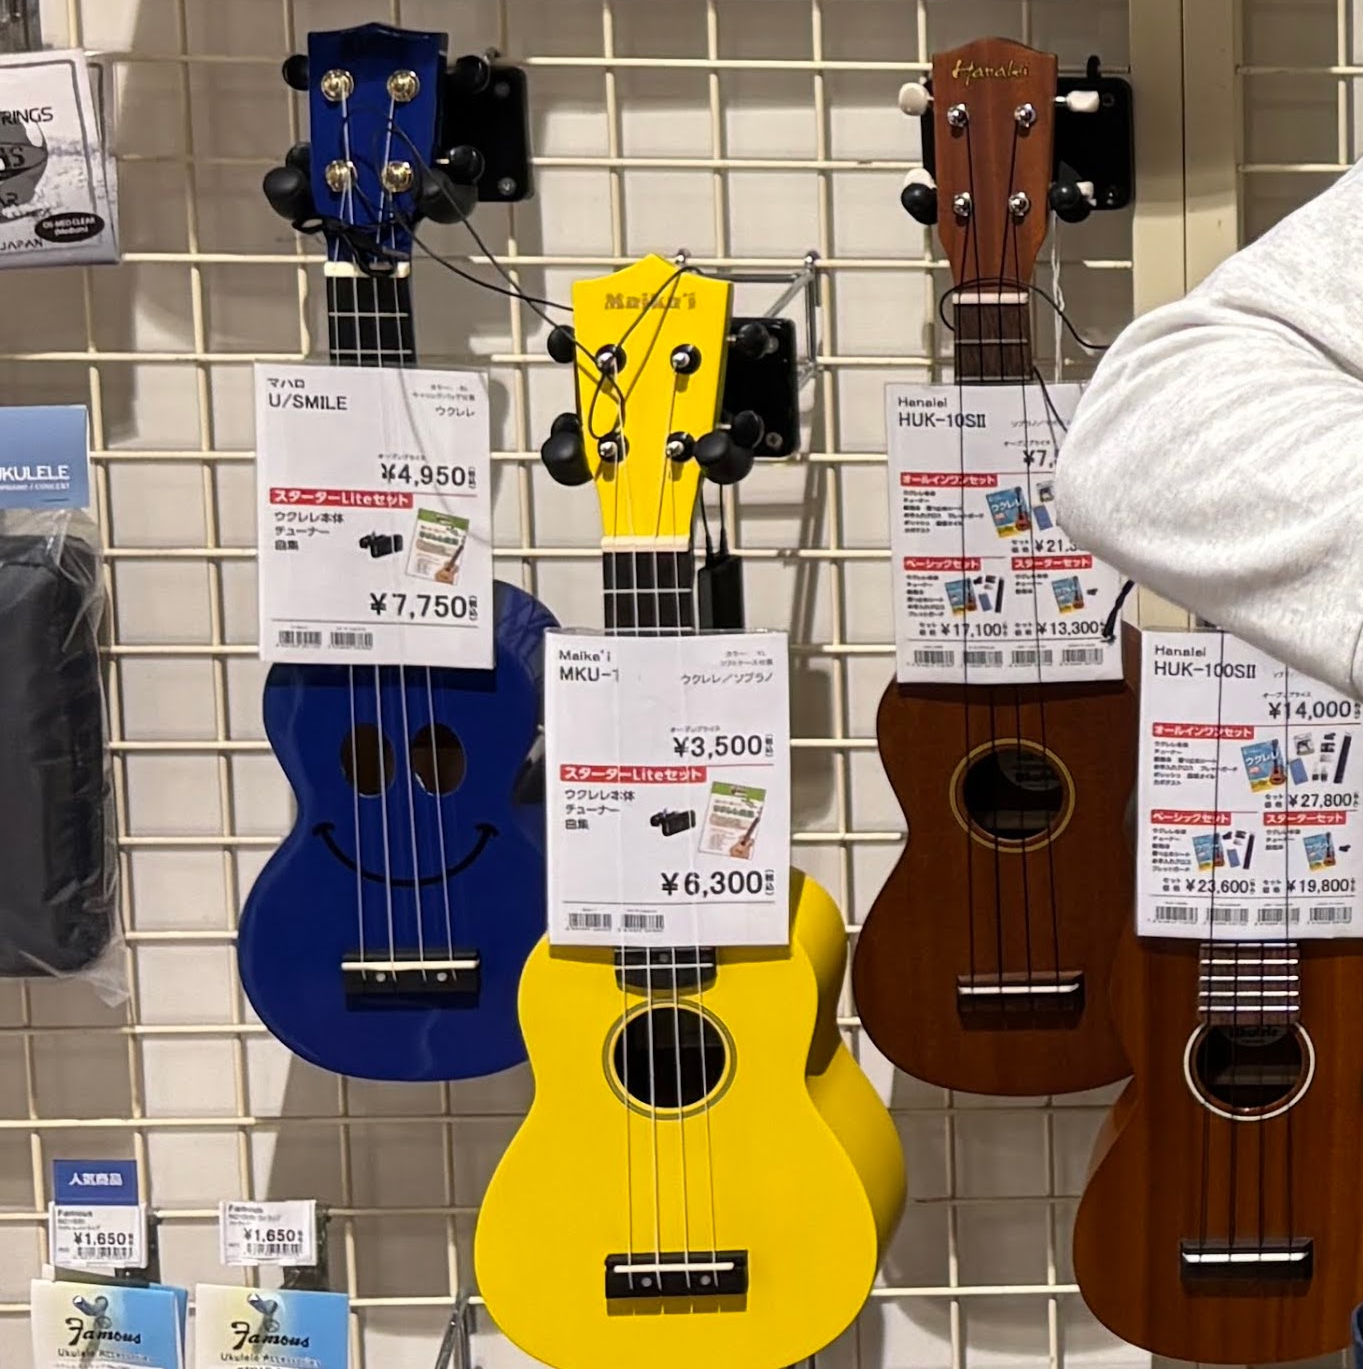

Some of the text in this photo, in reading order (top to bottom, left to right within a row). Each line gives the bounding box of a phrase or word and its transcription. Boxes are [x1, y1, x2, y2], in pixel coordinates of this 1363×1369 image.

[268, 378, 305, 389] マハロ
[269, 394, 348, 411] U/SMILE
[0, 465, 70, 481] KULELE
[381, 464, 466, 487] ¥4,950
[274, 490, 410, 507] スターターLiteセット
[274, 512, 344, 524] ウクレレ本体
[275, 527, 330, 537] チューナー
[1268, 700, 1352, 720] ¥14,000
[673, 735, 763, 759] ¥3,500
[564, 767, 703, 782] スターターLiteセット
[565, 805, 620, 815] チューナー
[69, 1173, 123, 1186] 人気商品
[65, 1317, 142, 1346] Famous
[231, 1321, 310, 1350] Famous
